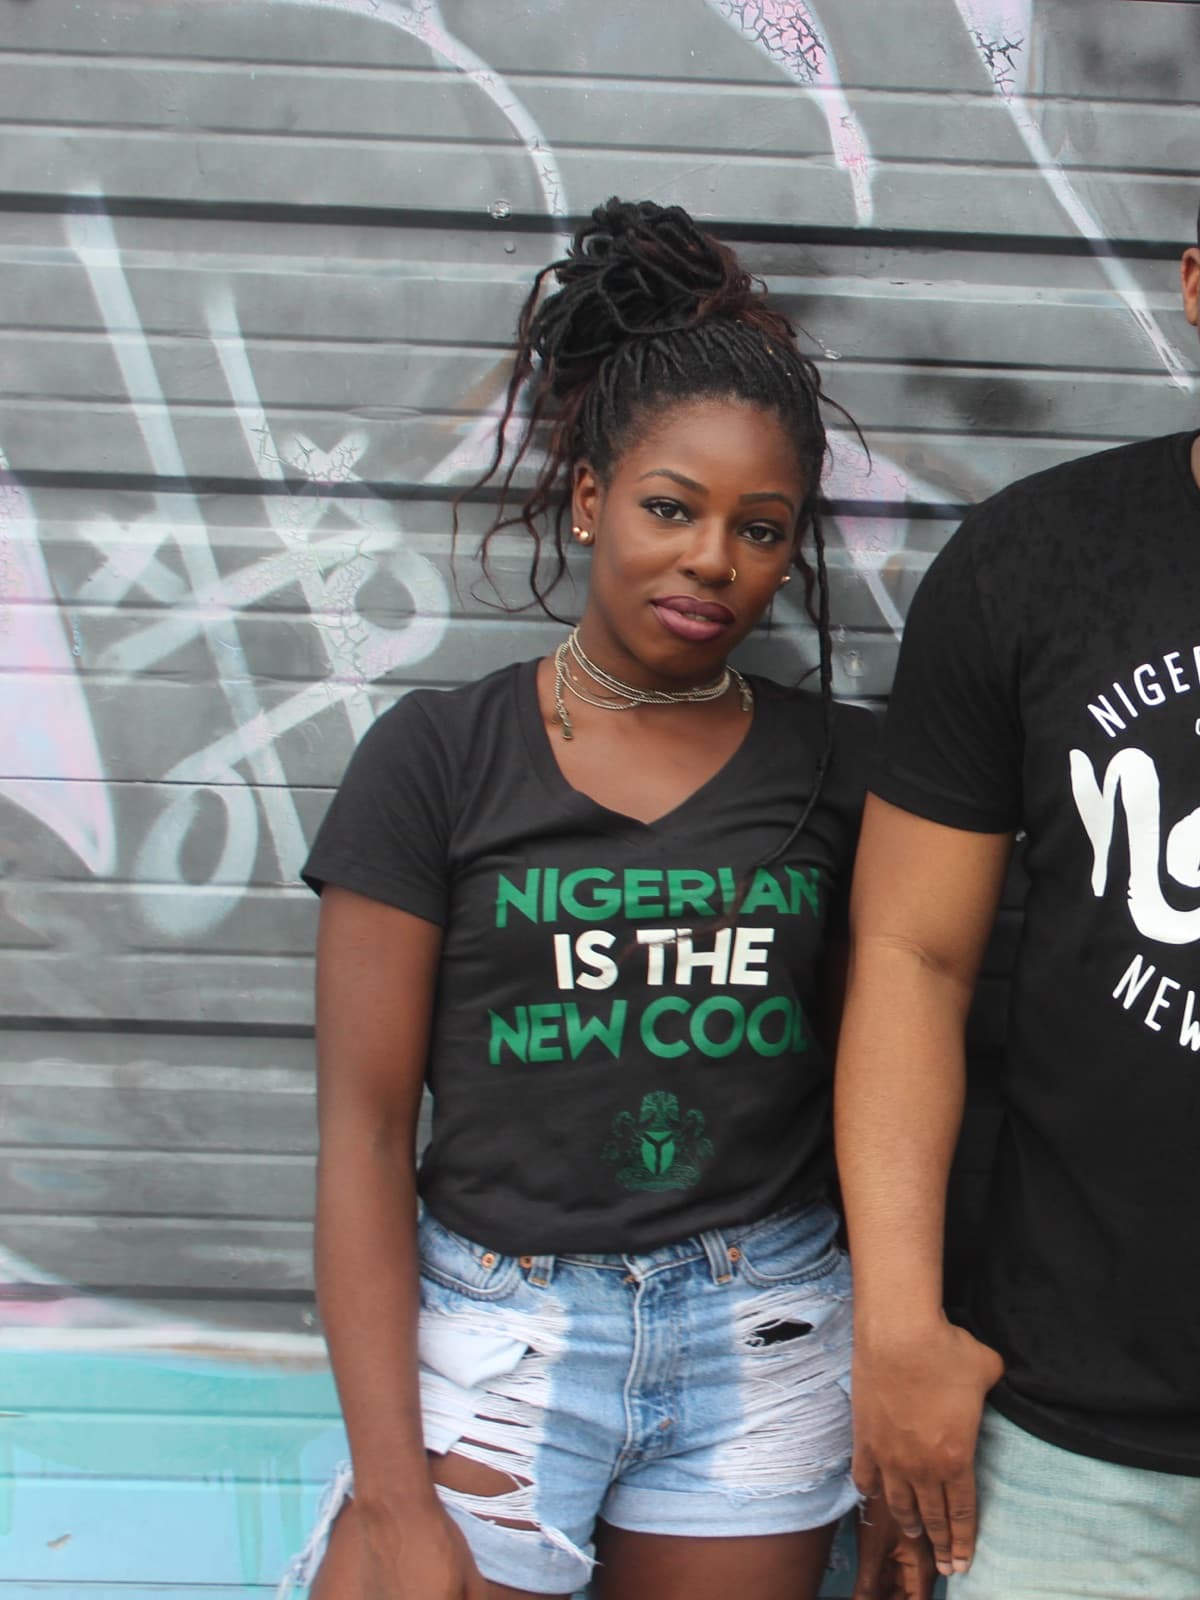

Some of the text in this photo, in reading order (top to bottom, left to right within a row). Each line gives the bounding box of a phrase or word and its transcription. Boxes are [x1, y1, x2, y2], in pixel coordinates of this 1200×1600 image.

[495, 866, 821, 928] NIGERIAN
[552, 926, 775, 991] IS THE
[487, 999, 628, 1065] NEW
